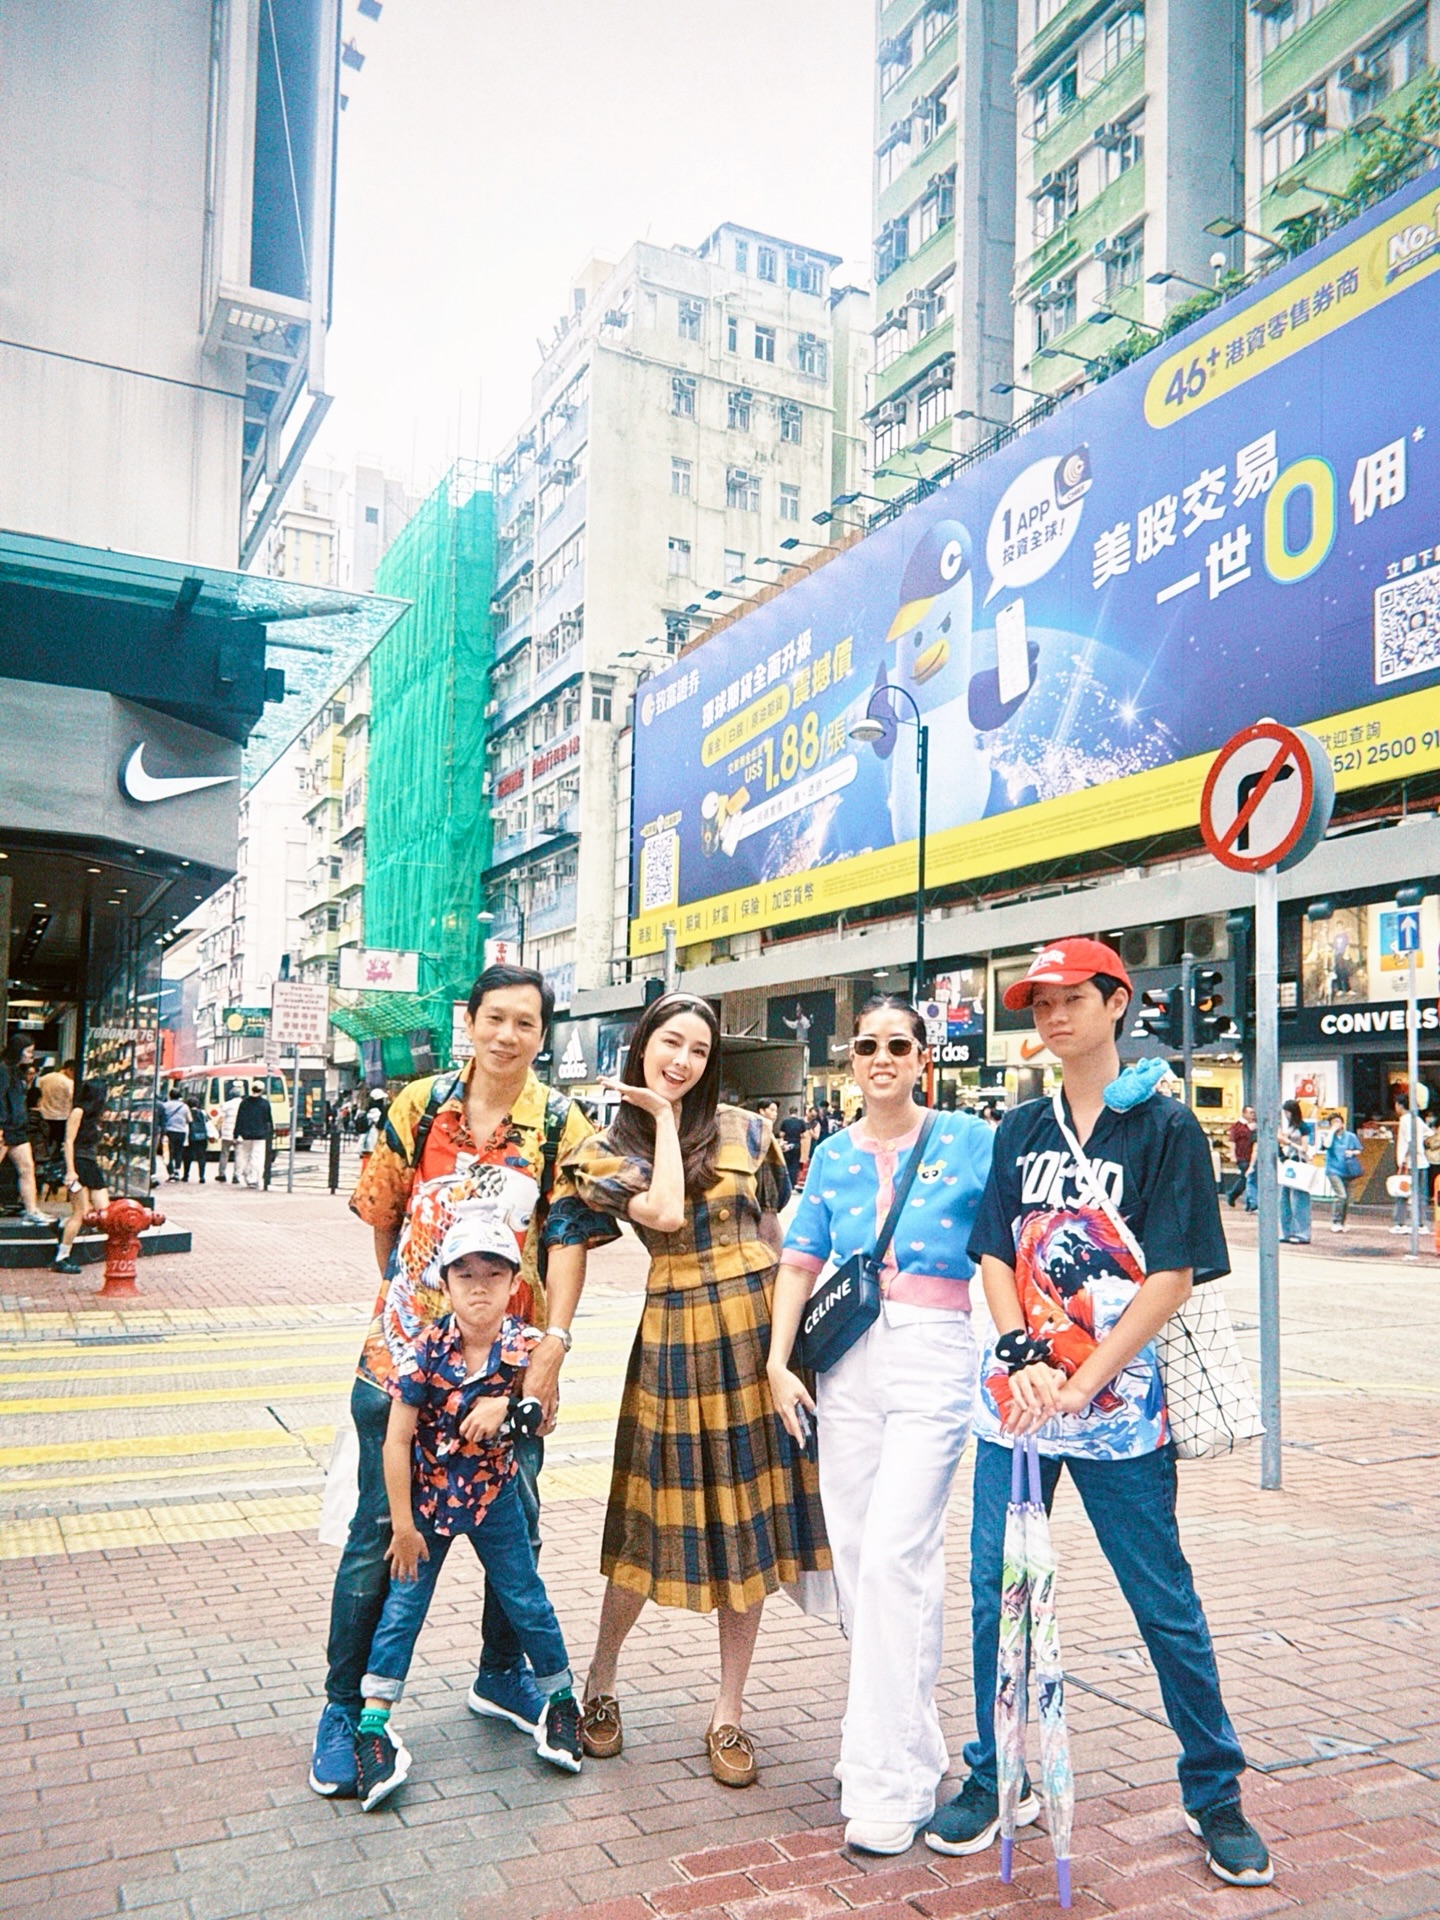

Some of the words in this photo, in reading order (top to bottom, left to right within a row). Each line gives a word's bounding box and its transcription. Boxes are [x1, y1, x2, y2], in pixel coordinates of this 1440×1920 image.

[1224, 267, 1360, 370] 港資零售券商
[1002, 508, 1012, 542] 1
[1016, 499, 1051, 535] APP
[1092, 430, 1277, 590] 美股交易
[1386, 544, 1440, 580] 立即下
[1333, 748, 1362, 773] 52)
[1366, 736, 1416, 766] 2500
[804, 1277, 852, 1334] CELINE
